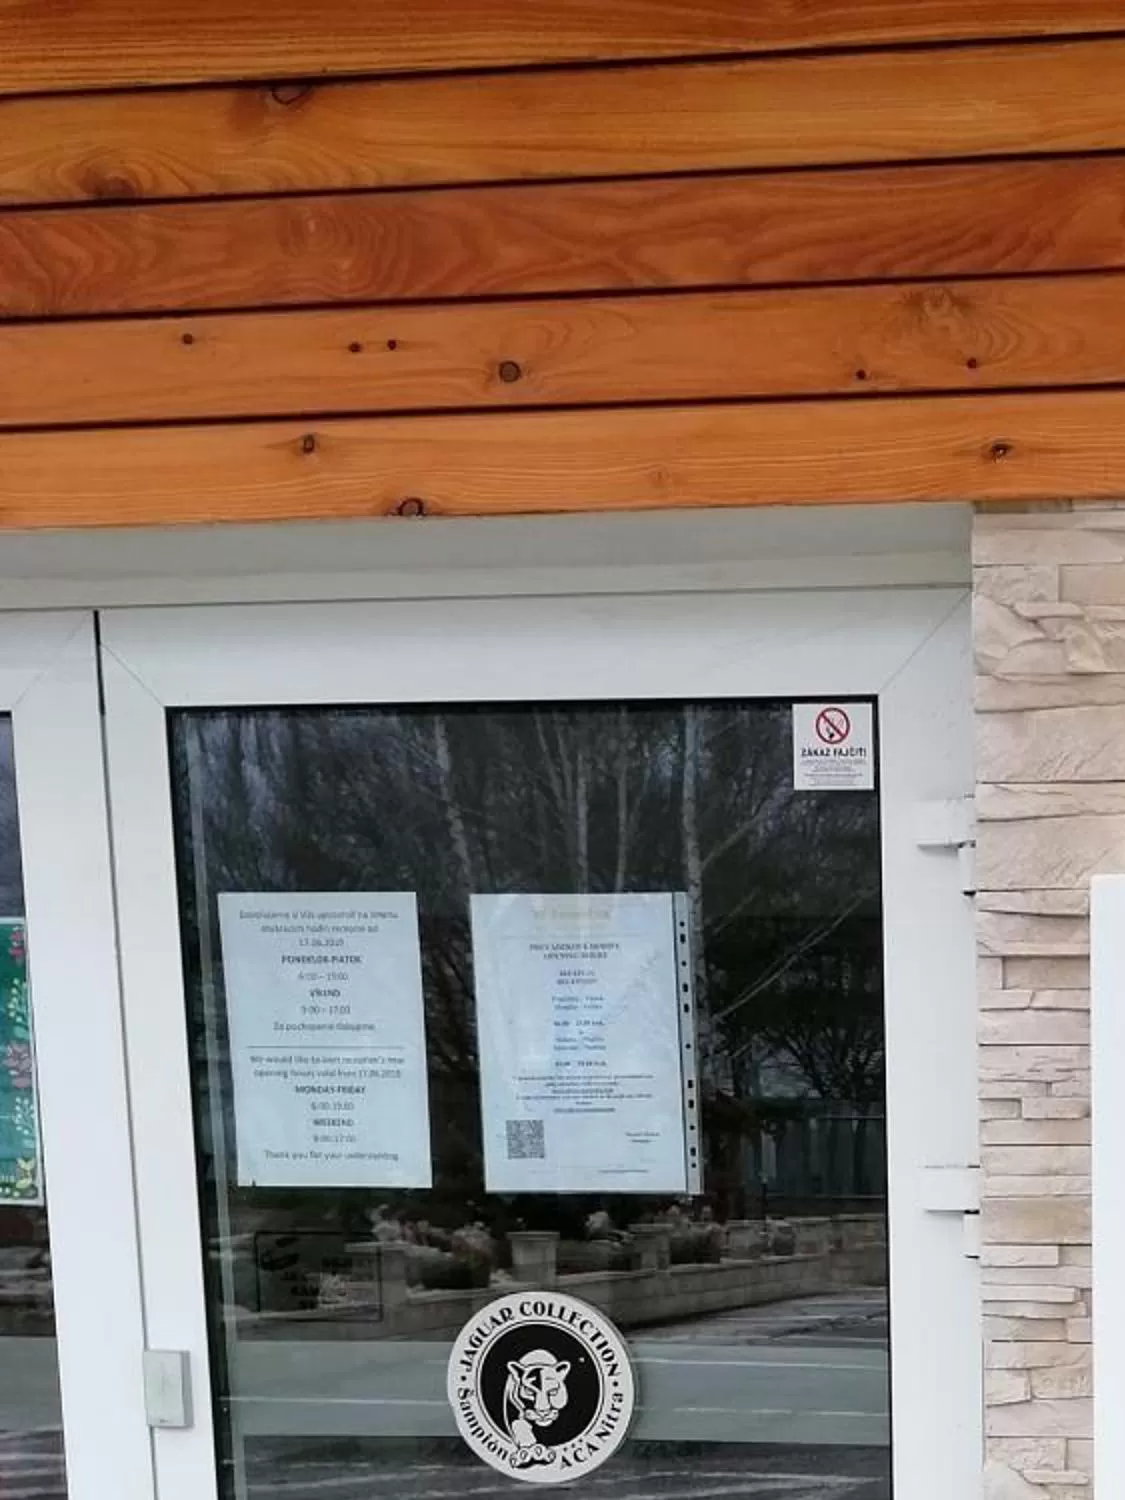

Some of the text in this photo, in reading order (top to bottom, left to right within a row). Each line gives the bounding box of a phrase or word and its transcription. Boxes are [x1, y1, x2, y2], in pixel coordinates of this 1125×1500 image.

[459, 1301, 622, 1378] JAGUAR COLLECTION
[457, 1386, 512, 1461] Šampión
[595, 1391, 625, 1444] Nitra
